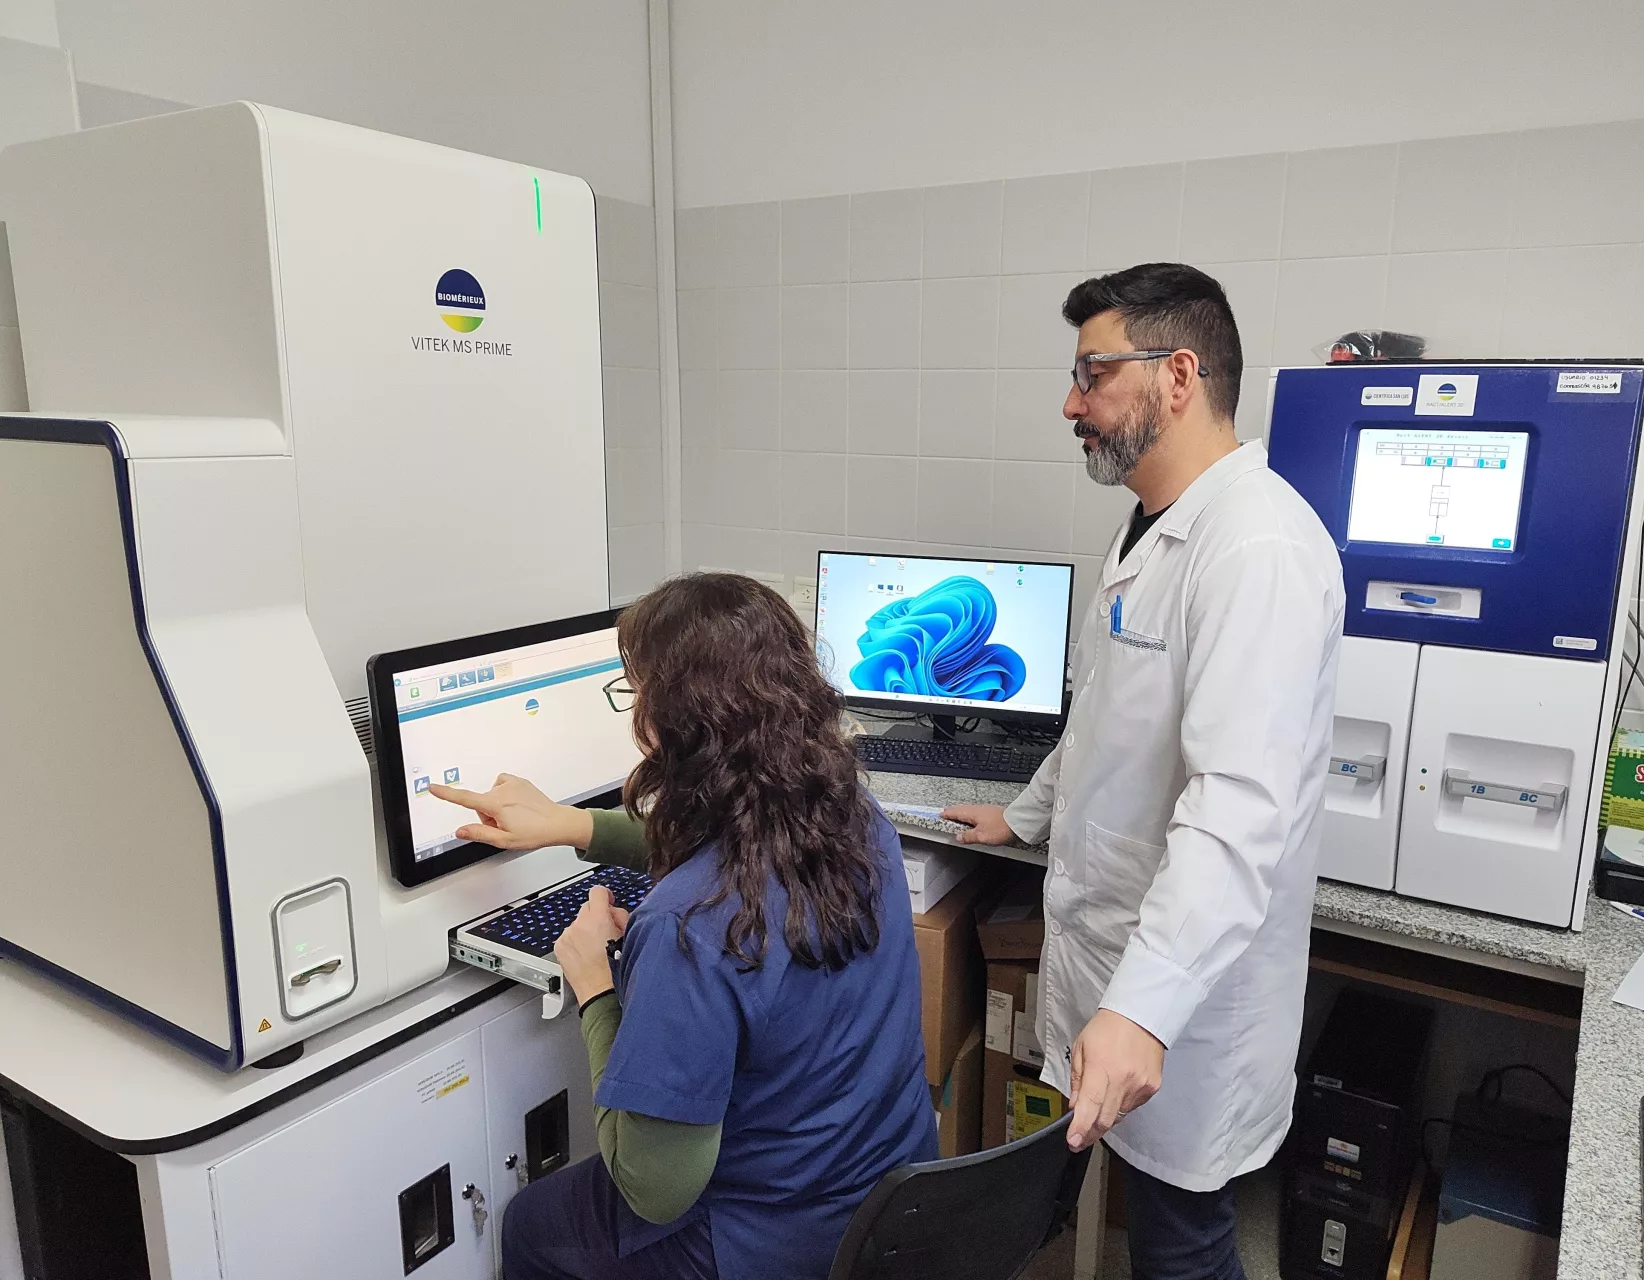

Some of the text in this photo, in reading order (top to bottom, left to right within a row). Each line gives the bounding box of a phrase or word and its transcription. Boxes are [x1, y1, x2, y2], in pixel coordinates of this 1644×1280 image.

[438, 292, 484, 304] BIOMÉRIEUX
[411, 336, 512, 356] VITEK MS PRIME
[1341, 763, 1358, 773] BC
[1471, 784, 1538, 803] 1B BC
